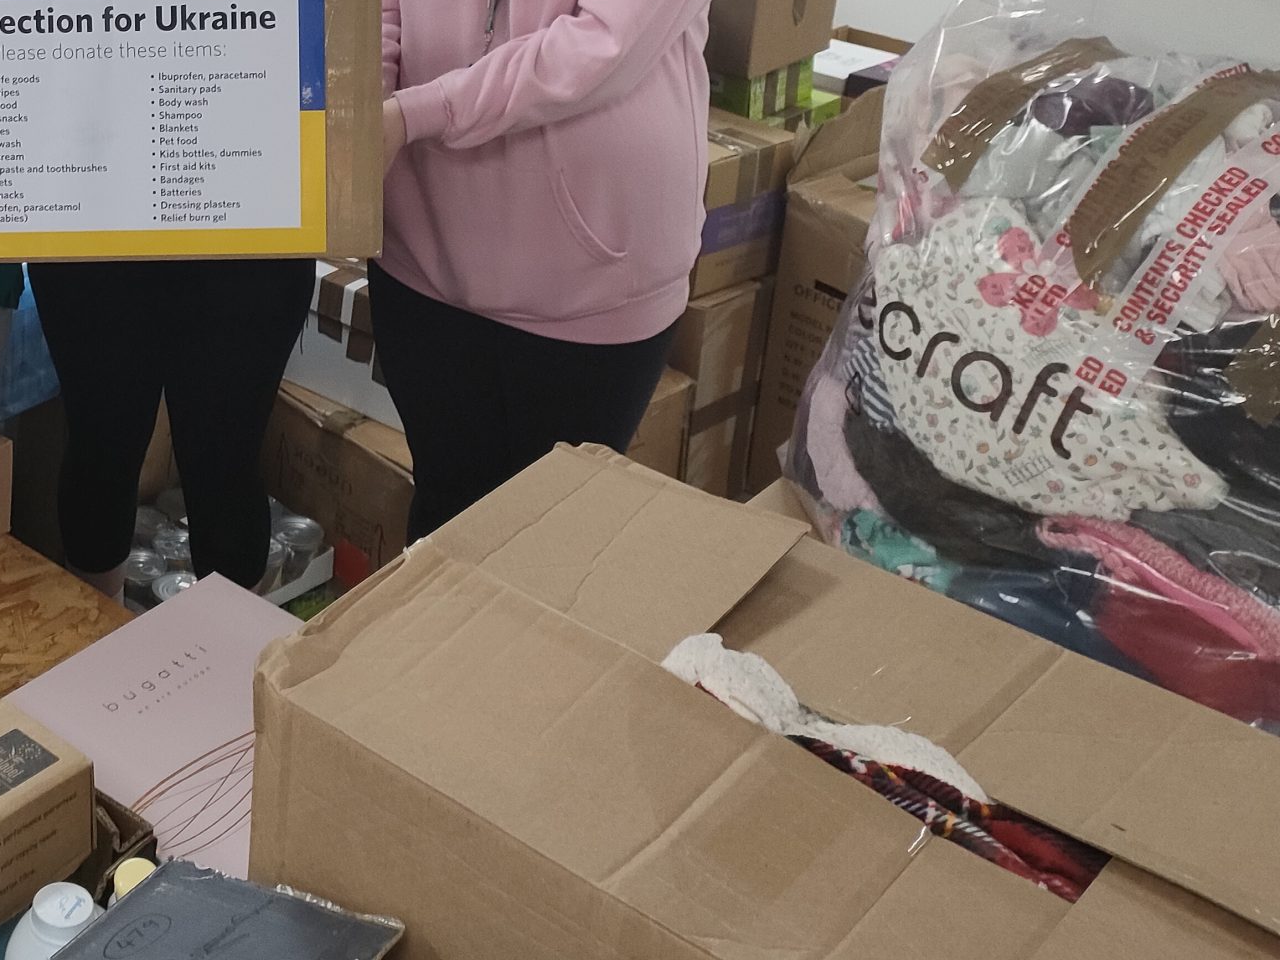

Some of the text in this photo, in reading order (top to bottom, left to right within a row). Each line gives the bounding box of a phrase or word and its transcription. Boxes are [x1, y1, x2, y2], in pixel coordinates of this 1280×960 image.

[101, 6, 147, 32] for
[155, 4, 276, 31] Ukraine
[52, 42, 113, 60] donate
[119, 41, 166, 59] these
[173, 41, 227, 58] items:
[11, 73, 41, 86] goods
[158, 69, 267, 83] Ibuprofen, paracetamol
[158, 83, 222, 96] Sanitary pads
[158, 97, 209, 109] Body wash
[158, 110, 203, 121] Shampoo
[159, 123, 199, 133] Blankets
[159, 135, 198, 146] Pet food
[159, 147, 263, 159] Kids bottles, dummies
[26, 164, 44, 174] and
[46, 163, 108, 174] toothbrushes
[159, 161, 217, 172] First aid kits
[160, 174, 205, 186] Bandages
[160, 187, 202, 197] Batteries
[23, 201, 81, 214] paracetamol
[160, 199, 241, 211] Dressing plasters
[160, 212, 227, 223] Relief burn gel
[1113, 239, 1186, 333] CONTENTS
[1176, 166, 1250, 239] CHECKED
[1134, 178, 1269, 346] & SECURITY SEALED
[1011, 274, 1047, 311] KED
[1075, 356, 1105, 384] ED
[1098, 368, 1128, 398] ED
[102, 644, 207, 712] bugatti
